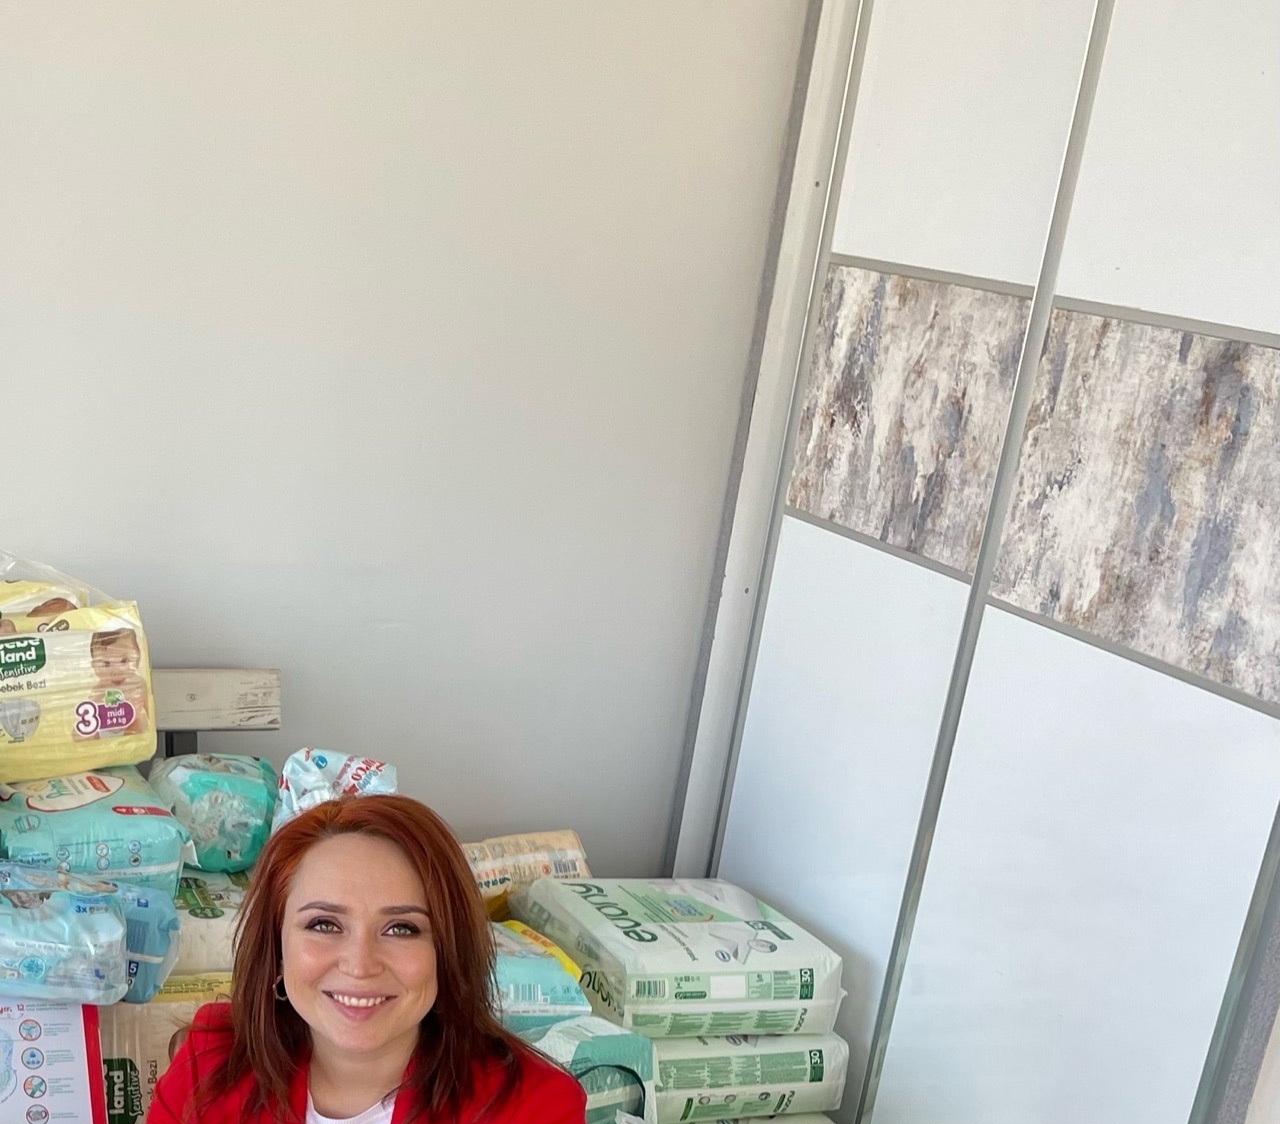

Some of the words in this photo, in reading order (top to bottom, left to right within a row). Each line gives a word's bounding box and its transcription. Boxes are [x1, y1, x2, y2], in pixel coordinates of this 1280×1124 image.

[0, 648, 37, 664] land
[76, 701, 99, 736] 3
[106, 709, 125, 718] midi
[129, 962, 137, 974] 5
[801, 968, 811, 983] 30
[16, 1003, 25, 1012] 12
[810, 1051, 821, 1065] 30
[147, 1059, 158, 1083] Bezi
[108, 1070, 125, 1115] land
